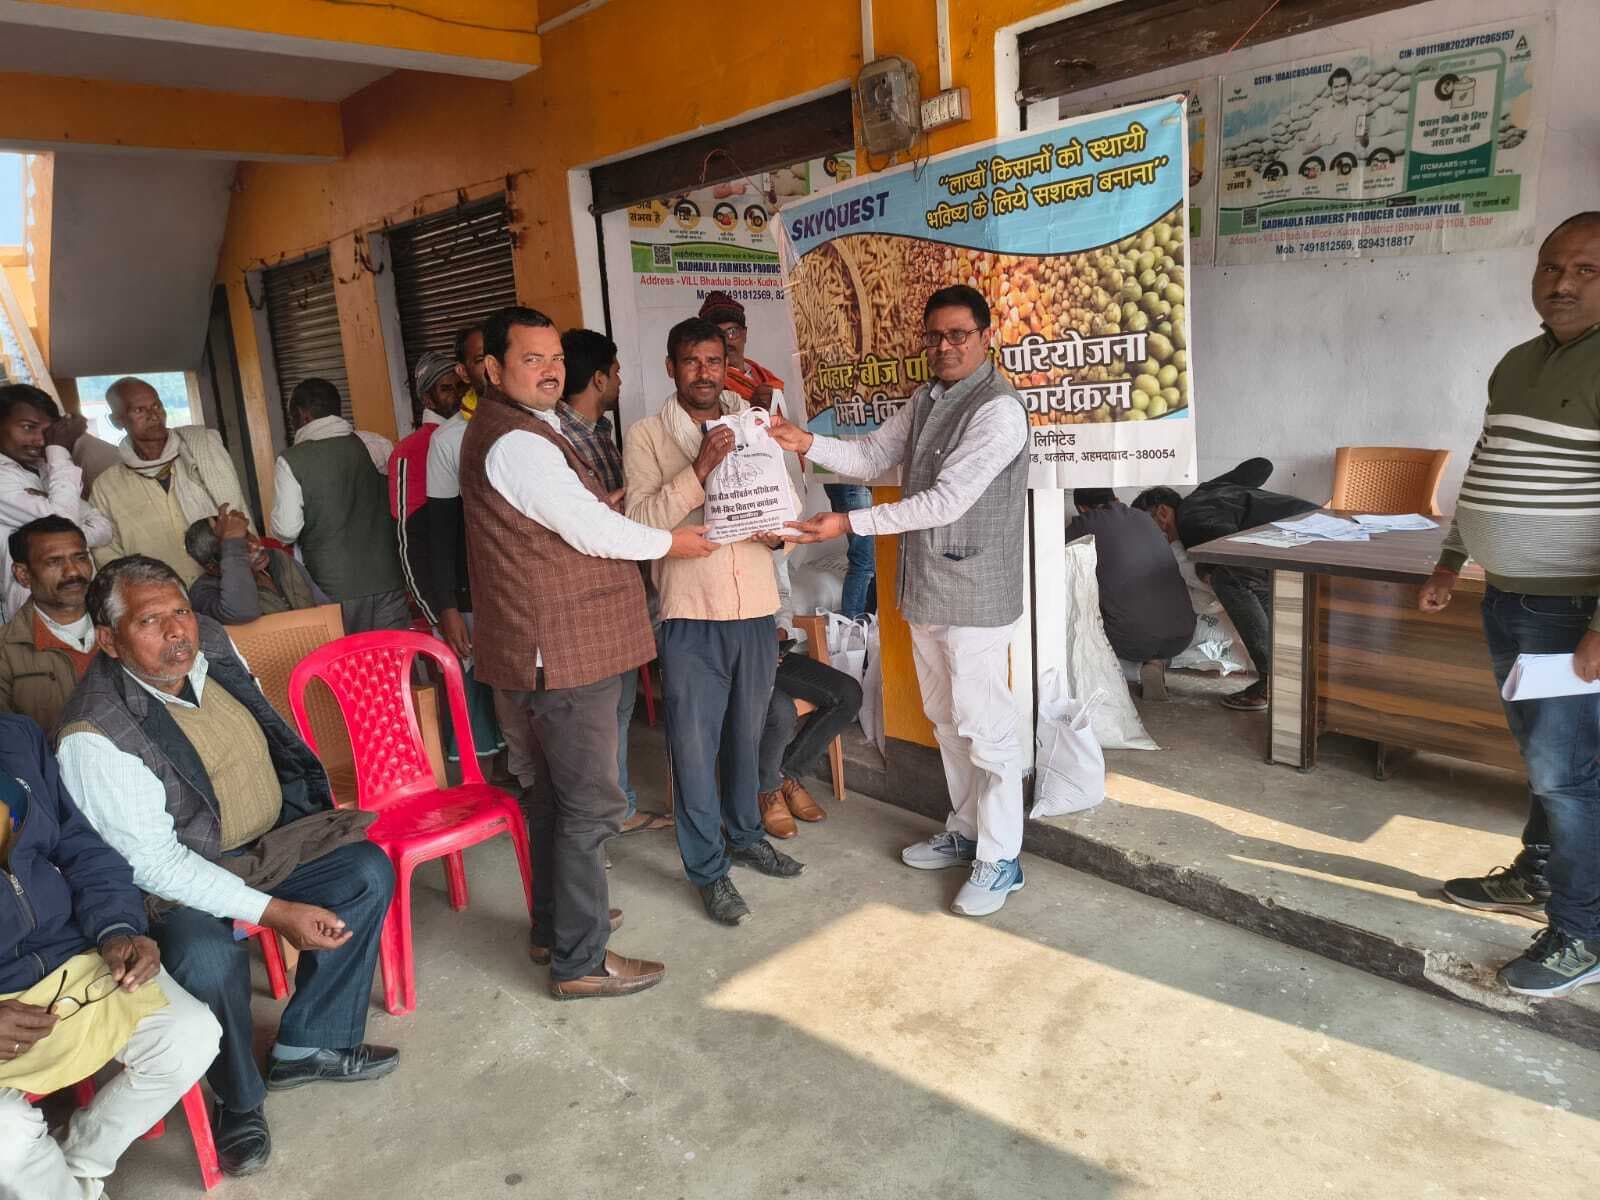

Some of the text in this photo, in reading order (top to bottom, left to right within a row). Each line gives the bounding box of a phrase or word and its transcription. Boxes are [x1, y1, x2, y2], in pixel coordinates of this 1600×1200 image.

[990, 144, 1052, 186] किसानों
[1055, 136, 1081, 169] को
[1087, 121, 1148, 162] स्थायी
[791, 191, 890, 242] SKYQUEST
[926, 200, 970, 231] भविष्य
[972, 196, 988, 221] के
[991, 187, 1028, 216] लिये
[1034, 175, 1093, 207] सशक्त
[1305, 212, 1345, 226] FARMERS
[1345, 207, 1394, 223] PRODUCER
[1396, 204, 1443, 218] COMPANY
[1276, 244, 1297, 255] Mob.
[1357, 235, 1415, 249] 8294318817
[640, 275, 675, 287] Address
[681, 275, 698, 286] VILL
[700, 276, 731, 286] Bhadula
[718, 262, 752, 273] FARMERS
[753, 263, 781, 274] PRODUC
[817, 361, 856, 391] बिहार
[858, 353, 899, 387] बीज
[1002, 330, 1149, 372] परियोजना
[834, 392, 910, 425] मिनी-कि
[1034, 431, 1076, 448] लिमिटेड
